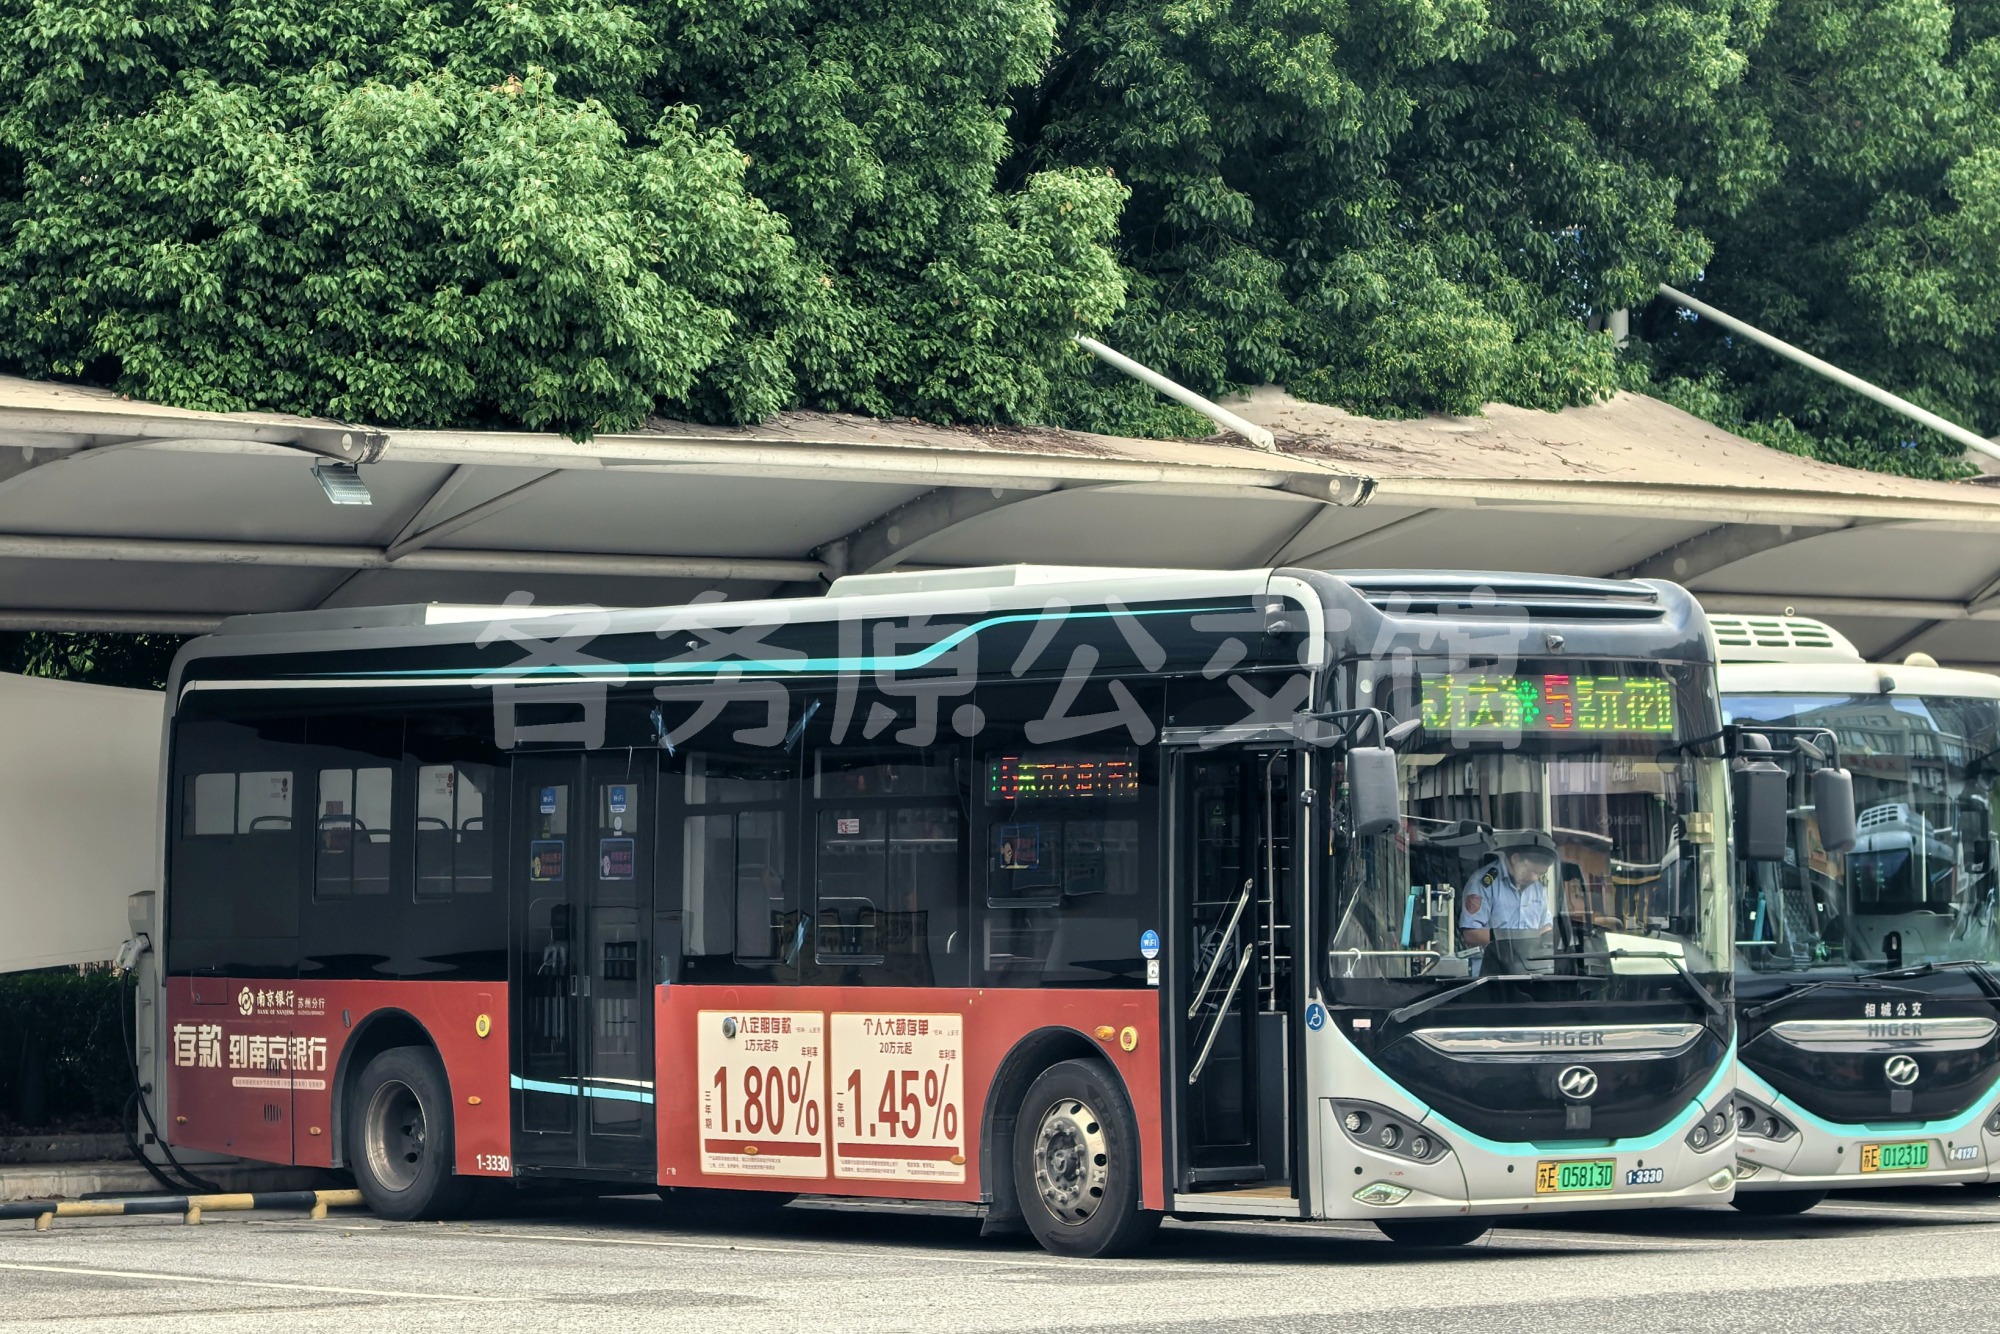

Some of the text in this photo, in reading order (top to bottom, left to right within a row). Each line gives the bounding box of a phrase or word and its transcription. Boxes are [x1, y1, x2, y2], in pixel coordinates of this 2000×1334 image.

[256, 989, 295, 1008] 南京银行
[863, 1018, 929, 1036] 个人大额存单
[1869, 1023, 1922, 1037] HIGER
[173, 1023, 327, 1072] 存款 到南京银行
[879, 1041, 913, 1055] 20万元起
[1540, 1030, 1604, 1047] HIGER
[714, 1060, 820, 1137] 1.80%
[847, 1063, 958, 1140] 1.45%
[476, 1153, 510, 1172] 1-3330
